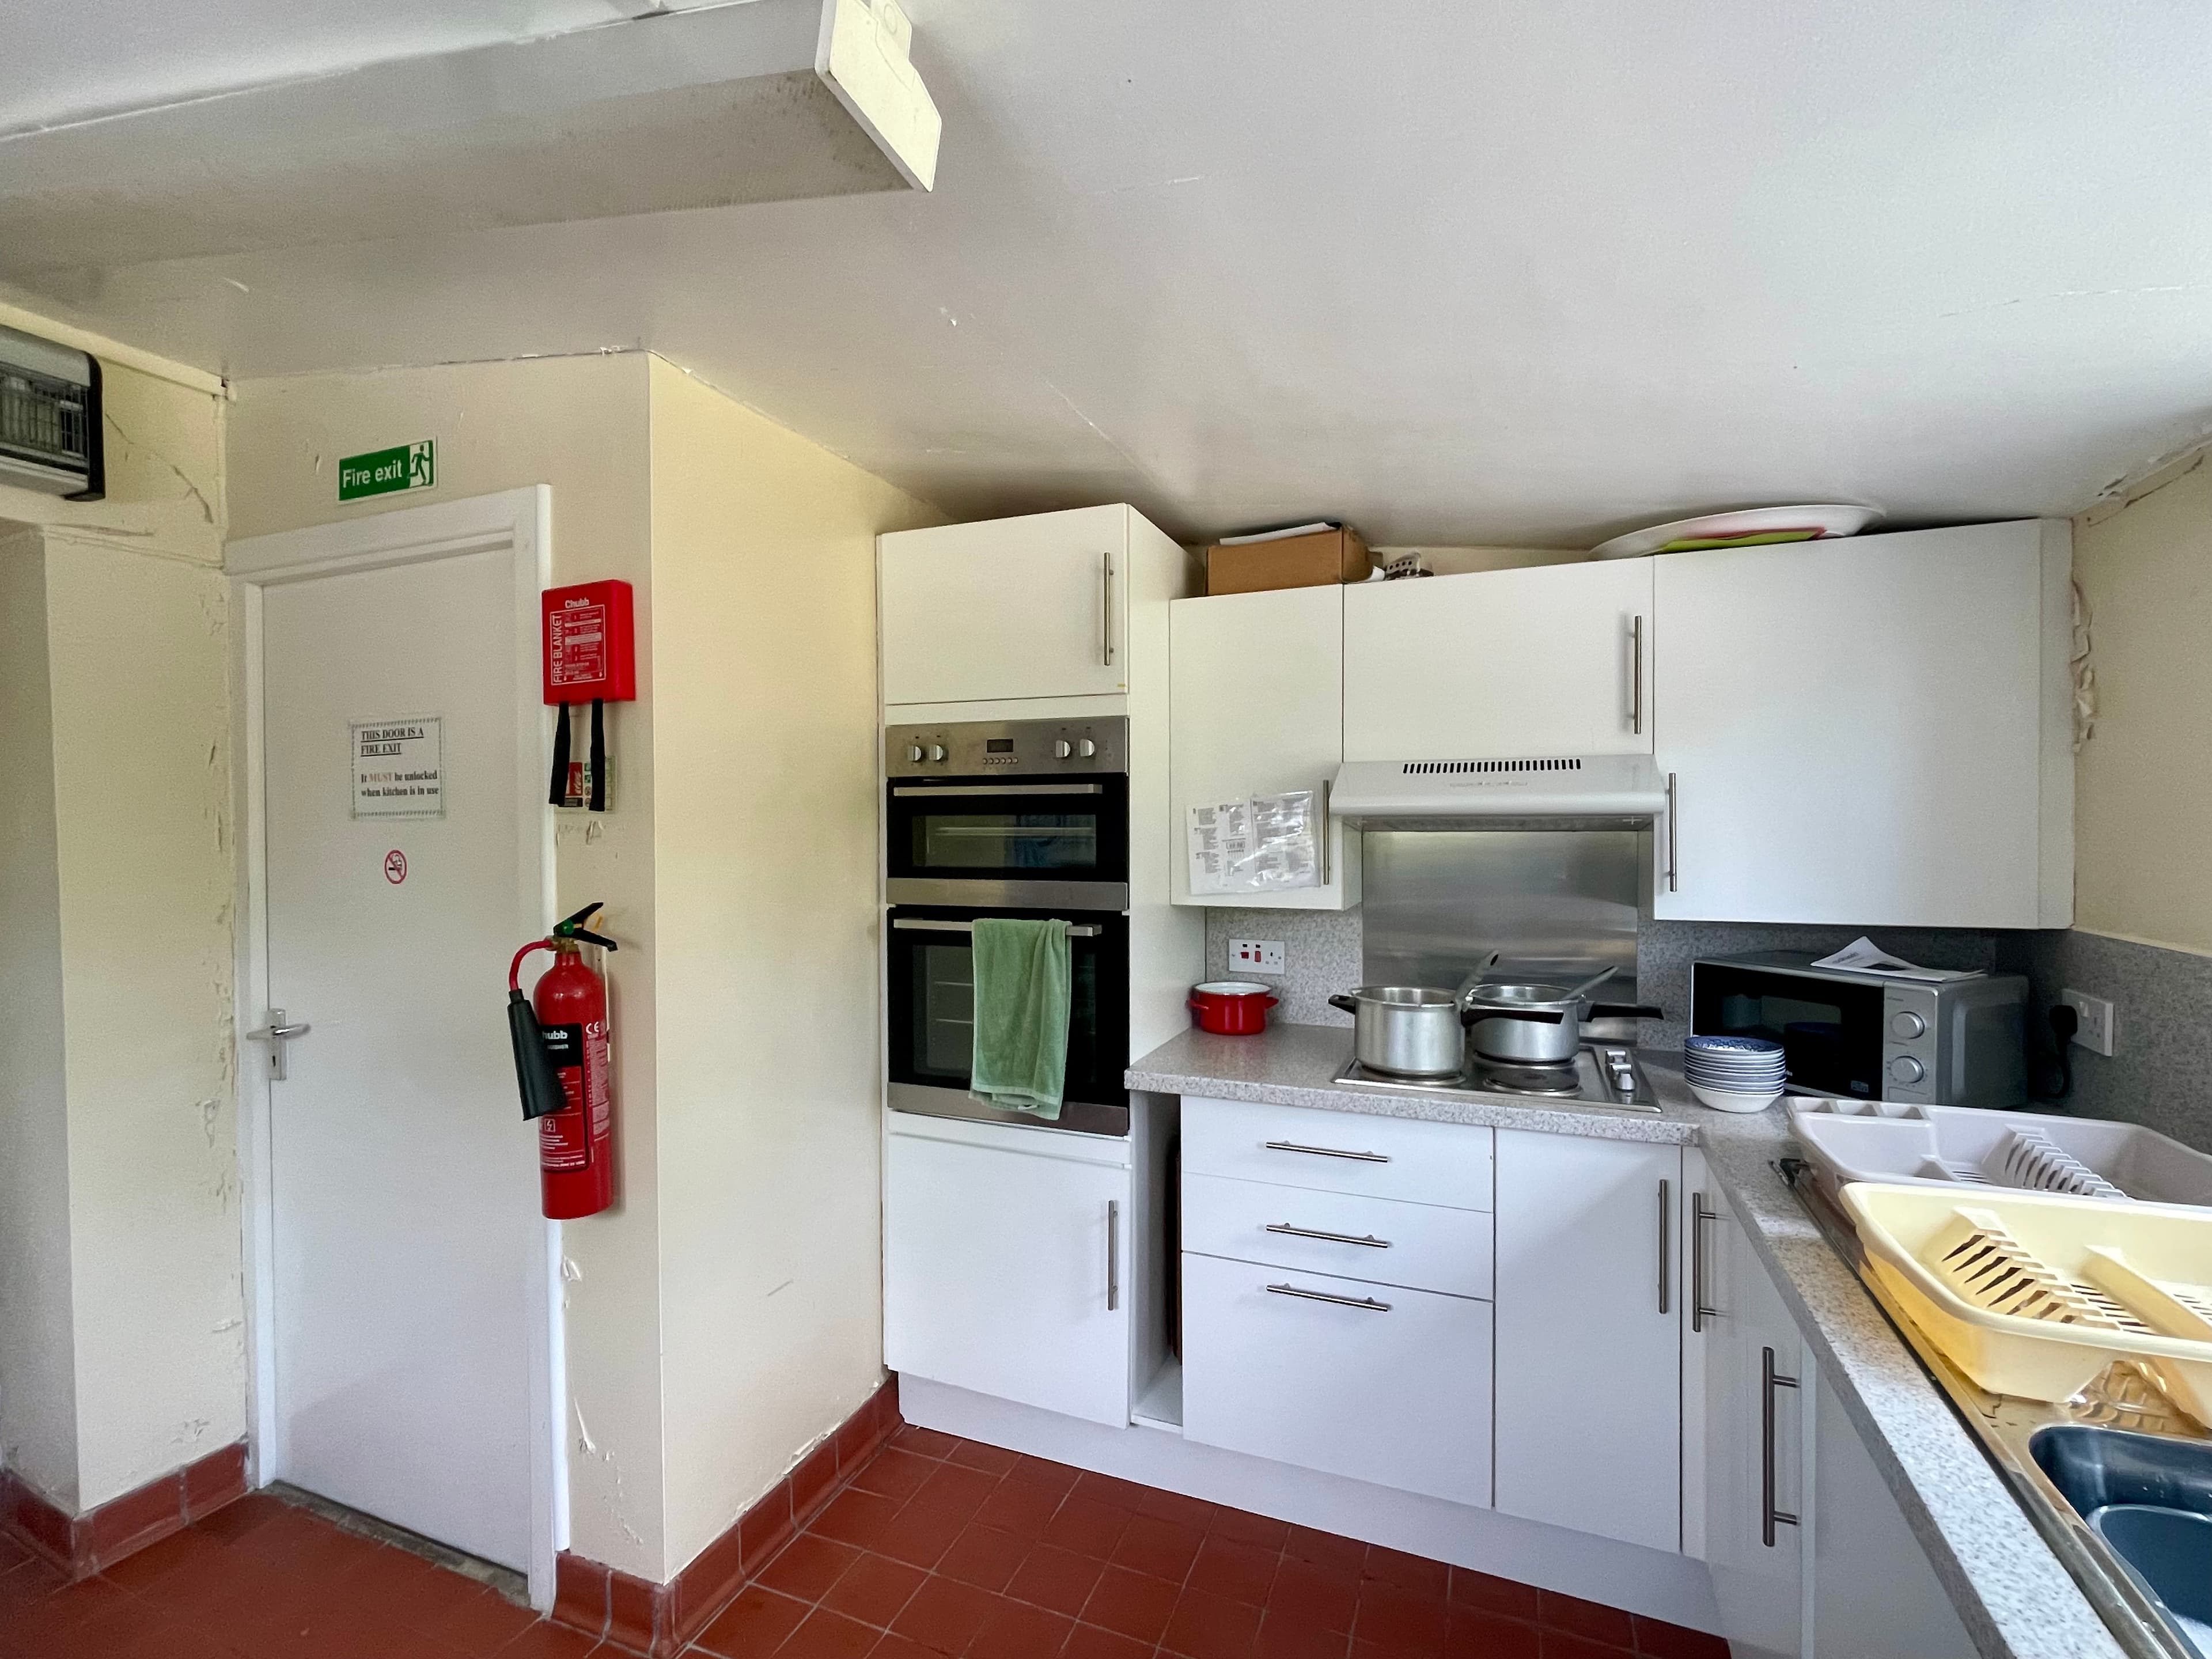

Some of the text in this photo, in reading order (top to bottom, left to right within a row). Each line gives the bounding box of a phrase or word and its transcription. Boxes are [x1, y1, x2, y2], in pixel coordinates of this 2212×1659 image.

[343, 460, 402, 488] Fire exit
[565, 598, 589, 609] Chubb
[552, 615, 563, 683] FIRE BLANKET
[362, 727, 424, 740] THIS DOOR IS A
[361, 743, 402, 754] FIRE EXIT
[361, 770, 437, 783] It MUST be unlocked
[361, 787, 381, 797] when
[382, 786, 408, 796] kitchen
[410, 786, 415, 795] is
[418, 786, 425, 795] in
[586, 1021, 599, 1034] CE
[542, 1030, 568, 1039] hubb
